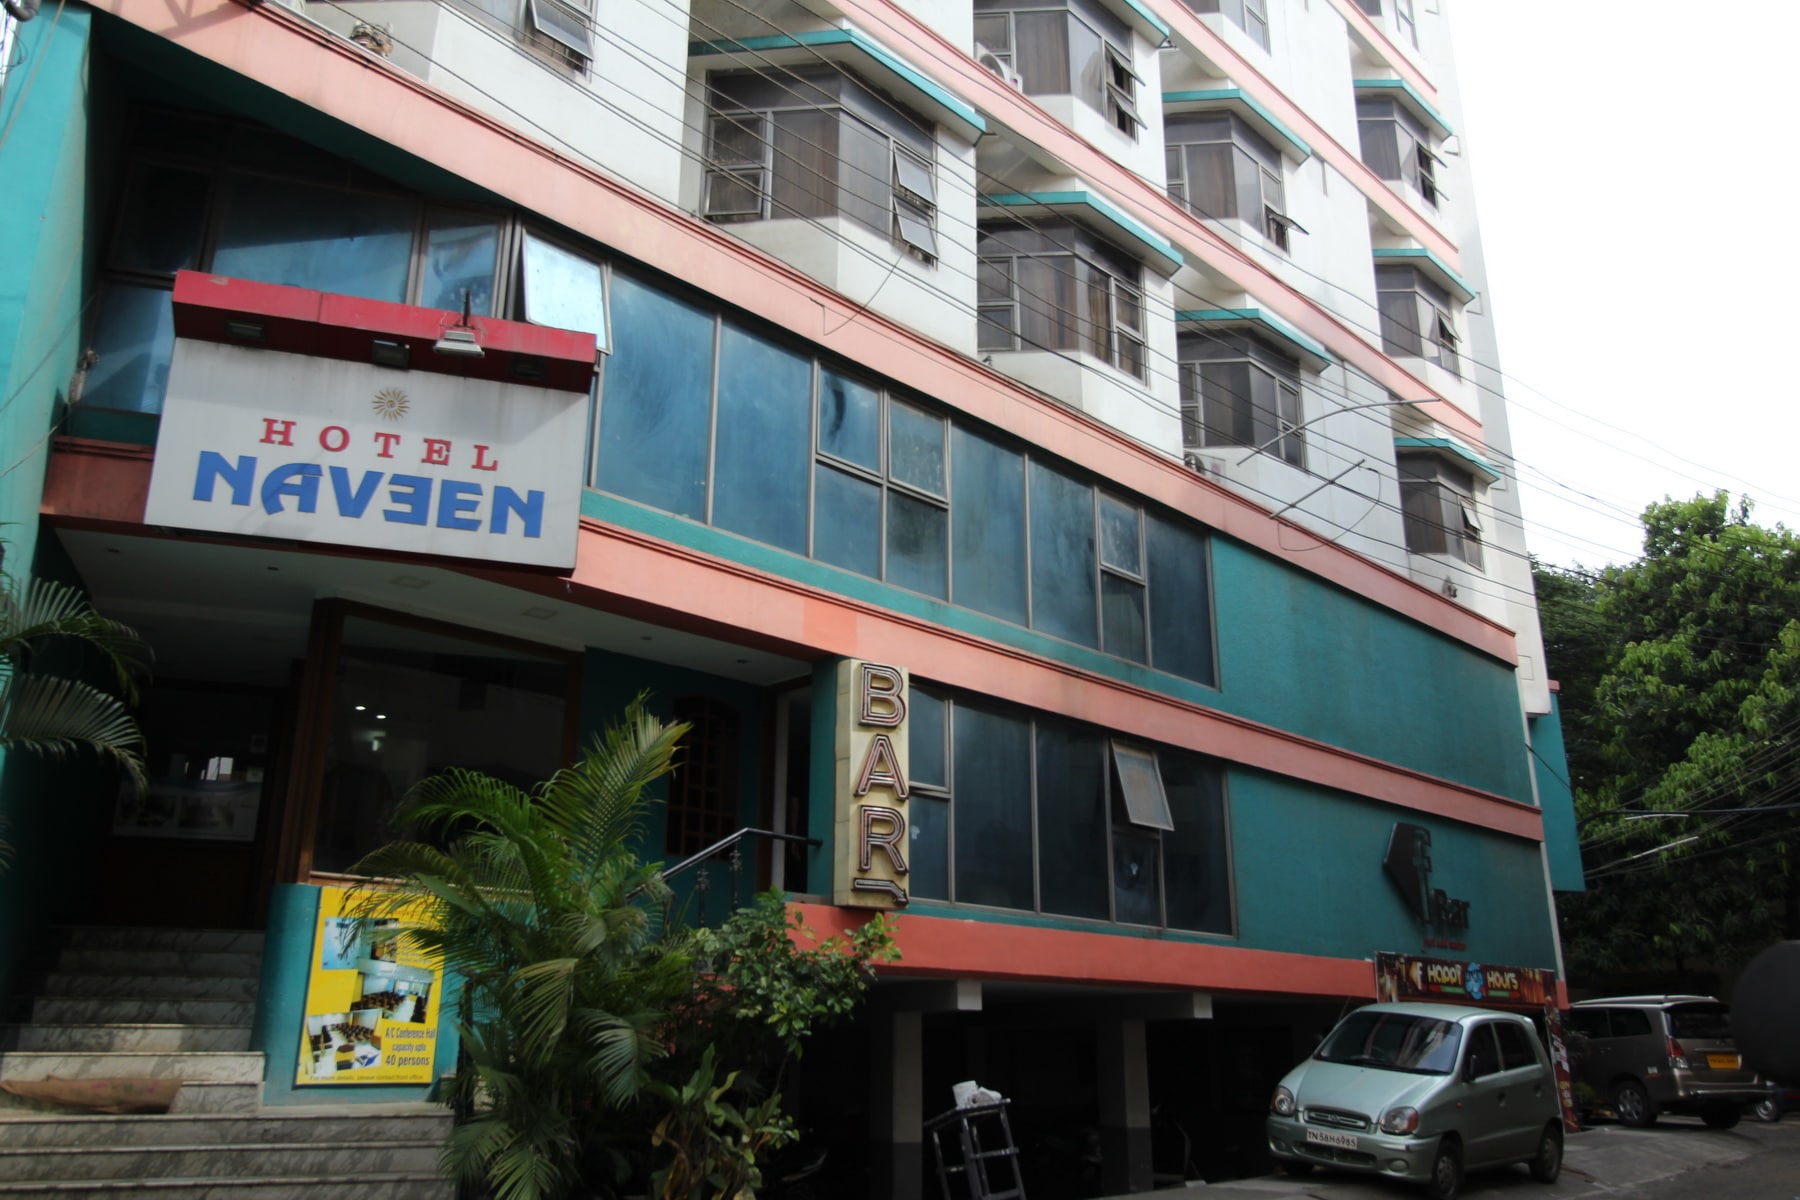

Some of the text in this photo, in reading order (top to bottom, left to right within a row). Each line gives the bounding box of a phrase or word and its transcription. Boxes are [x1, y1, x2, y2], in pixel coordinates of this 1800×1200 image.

[259, 417, 499, 472] HOTEL
[192, 450, 546, 539] NAVEEN
[854, 662, 910, 875] BAR
[385, 1054, 430, 1067] 40 persons
[396, 1028, 424, 1038] Conference
